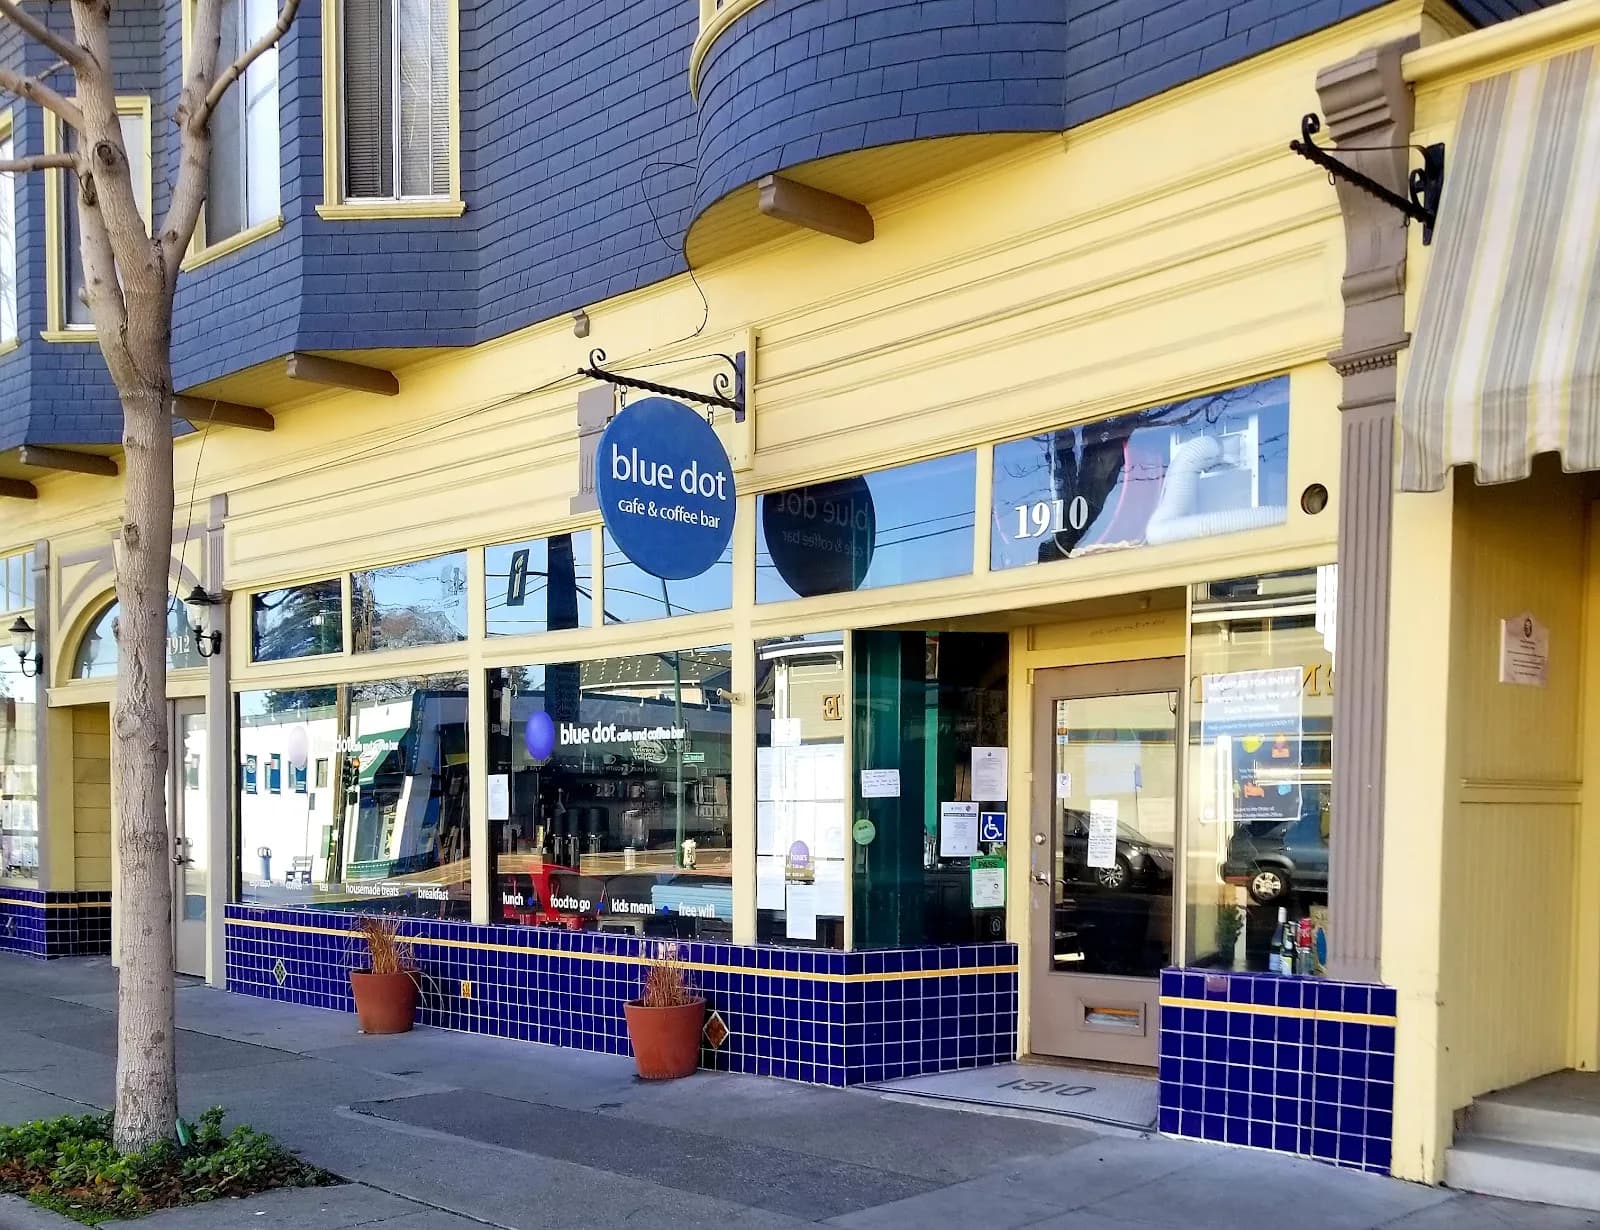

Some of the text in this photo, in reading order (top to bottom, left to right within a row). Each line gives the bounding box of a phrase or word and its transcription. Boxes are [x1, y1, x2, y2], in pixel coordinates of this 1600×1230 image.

[612, 443, 727, 501] blue dot
[618, 497, 720, 529] cafe & coffee bar
[1014, 495, 1089, 539] 1910
[166, 635, 190, 655] 1912
[560, 721, 685, 745] blue dot cafe and coffee bar
[345, 882, 381, 895] housemade
[381, 884, 399, 897] treats
[417, 887, 449, 901] breakfast
[502, 891, 715, 918] lunch food to go kids menu free wifi
[996, 1078, 1096, 1096] 1910
